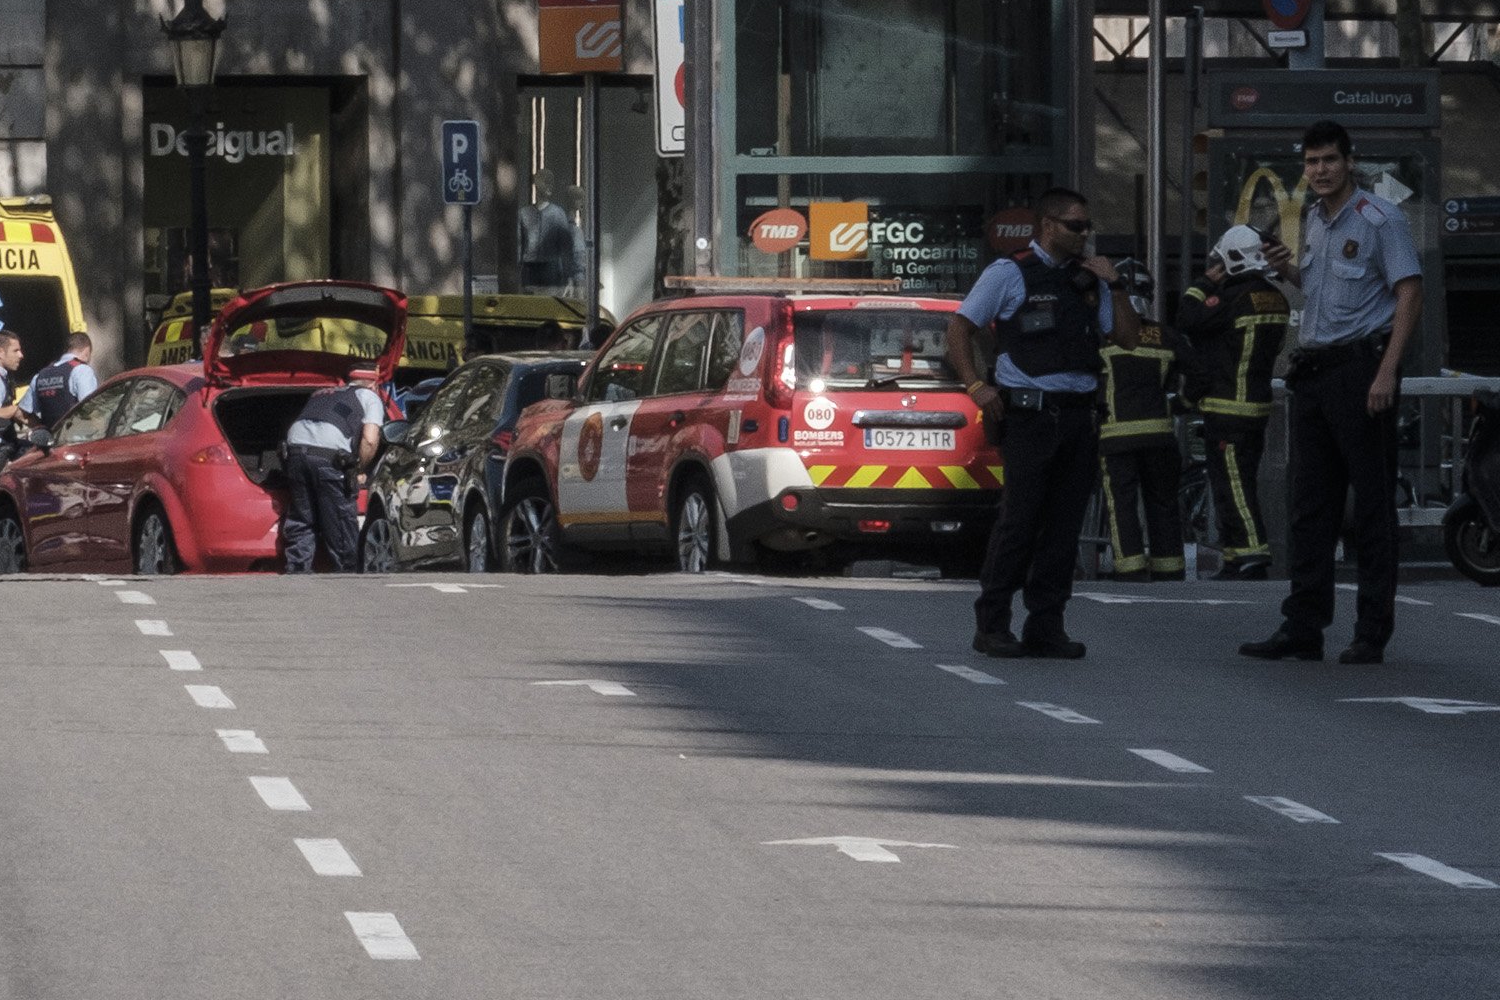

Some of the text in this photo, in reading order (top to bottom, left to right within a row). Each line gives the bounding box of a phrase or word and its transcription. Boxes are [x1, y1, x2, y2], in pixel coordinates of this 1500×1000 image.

[1333, 90, 1413, 108] Catalunya
[452, 133, 468, 163] P
[761, 224, 799, 239] TMB
[871, 222, 924, 243] FGC
[996, 224, 1034, 238] TMB
[807, 409, 832, 420] 080
[793, 430, 844, 441] BOMBERS
[875, 431, 951, 446] 0572 HTR
